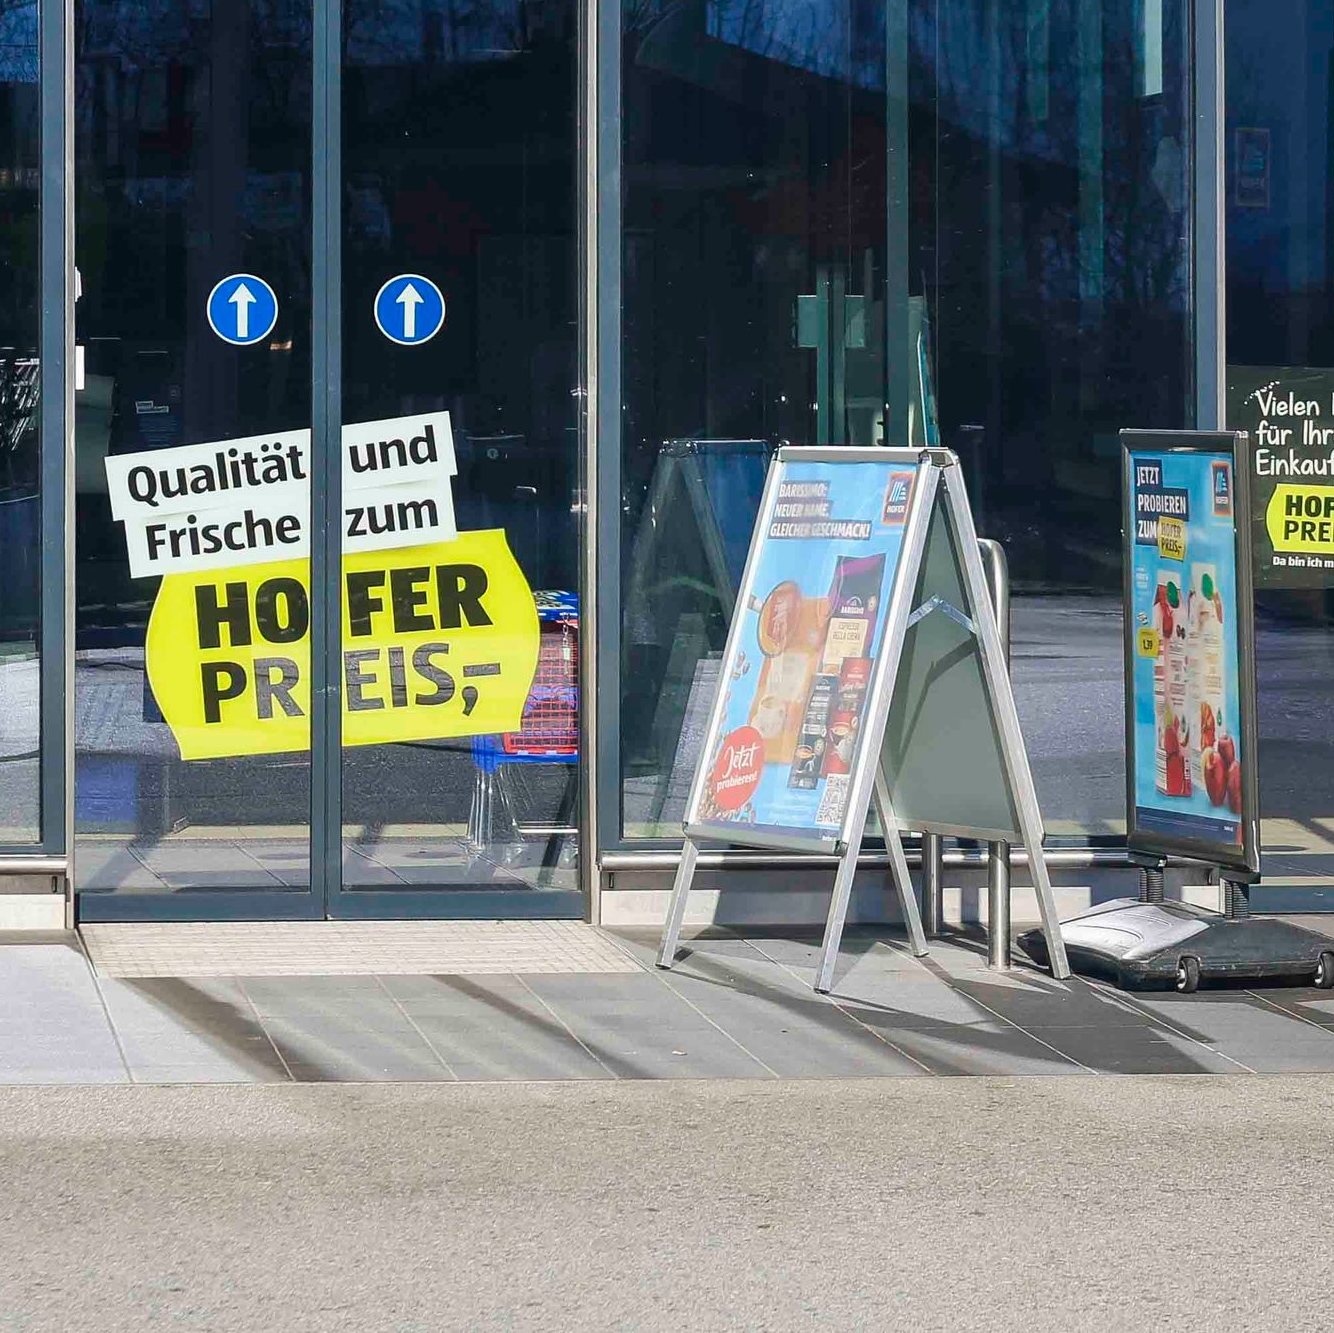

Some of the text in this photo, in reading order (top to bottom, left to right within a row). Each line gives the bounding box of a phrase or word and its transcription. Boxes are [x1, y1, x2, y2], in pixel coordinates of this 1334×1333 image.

[1257, 391, 1320, 417] Vielen
[1256, 420, 1292, 445] für
[127, 424, 439, 507] Qualität und
[1136, 466, 1160, 487] JETZT
[775, 503, 801, 517] NEUER
[886, 505, 905, 513] HOFER
[1138, 494, 1186, 515] PROBIEREN
[146, 497, 439, 561] Frische zum
[770, 523, 870, 537] GLEICHER GESCHMACK!
[1138, 520, 1157, 538] ZUM
[1272, 556, 1287, 566] Da
[1288, 556, 1305, 567] bin
[1307, 556, 1323, 567] ich
[721, 743, 762, 778] Jetzt
[716, 772, 758, 793] probieren!
